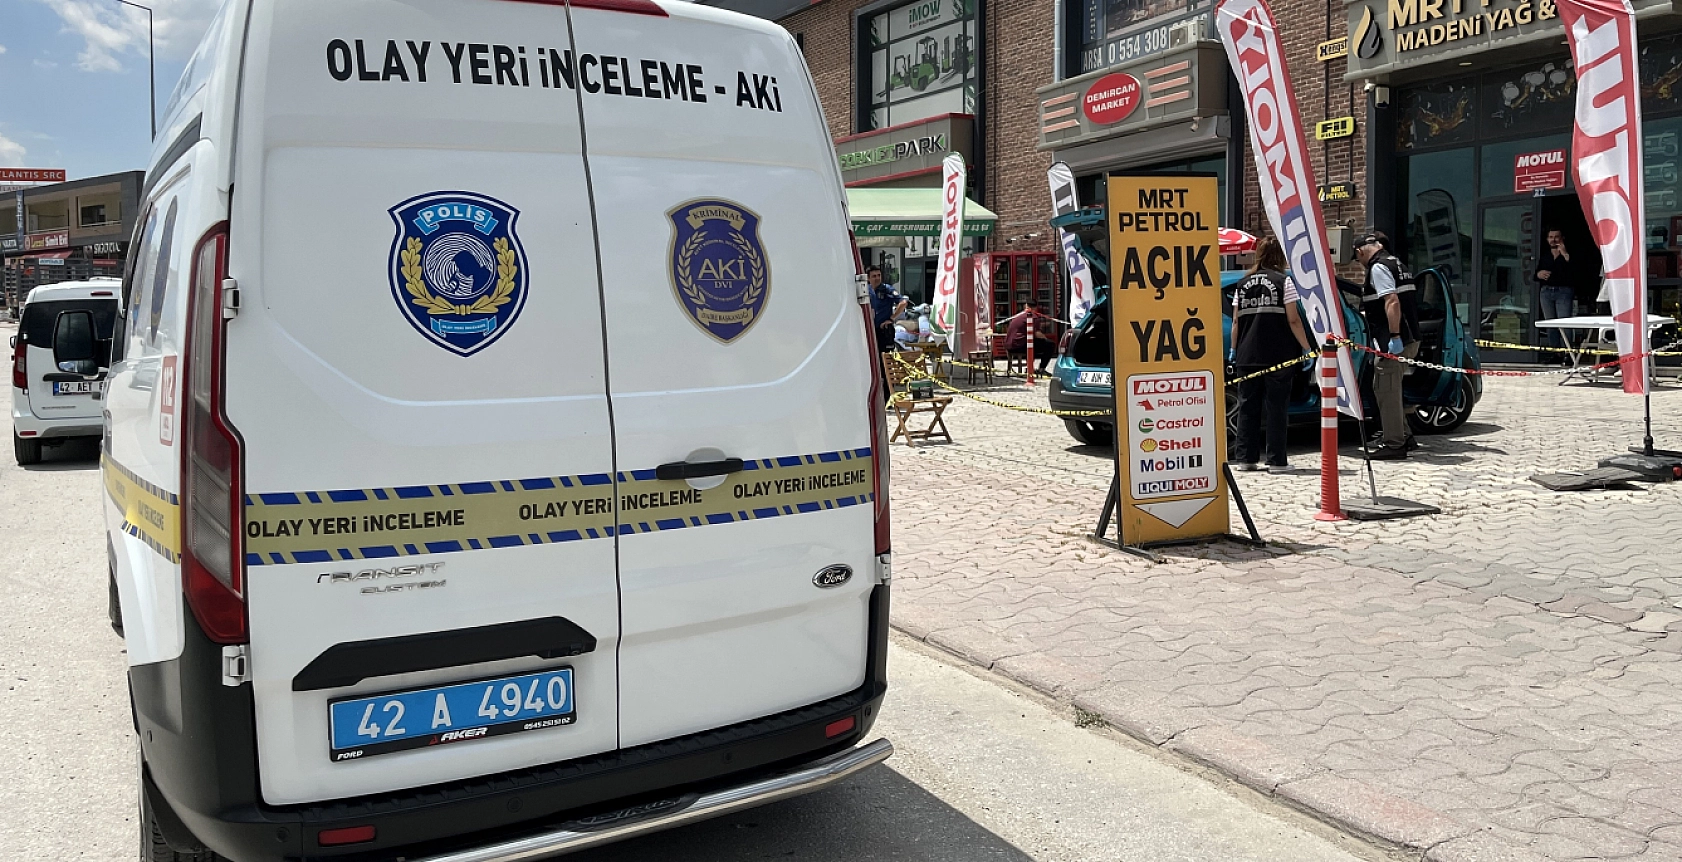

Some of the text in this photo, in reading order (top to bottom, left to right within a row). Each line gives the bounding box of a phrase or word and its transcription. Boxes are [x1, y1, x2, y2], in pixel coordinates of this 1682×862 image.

[1537, 1, 1556, 20] &
[1083, 47, 1102, 72] ARSA
[1119, 35, 1140, 60] 554
[1144, 26, 1168, 53] 308
[326, 38, 431, 82] OLAY
[1091, 97, 1131, 115] MARKET
[1516, 151, 1564, 168] MOTUL
[43, 171, 63, 179] SRC
[1138, 189, 1188, 209] MRT
[422, 205, 486, 223] POLİS
[1119, 212, 1209, 232] PETROL
[1120, 245, 1213, 300] AÇIK
[714, 280, 733, 289] DVI
[1130, 308, 1206, 363] YAĞ
[60, 382, 70, 392] 42
[1136, 377, 1204, 394] MOTUL
[1157, 396, 1207, 408] Petrol Ofisi
[1156, 416, 1204, 430] Castrol
[1158, 437, 1201, 451] Shell
[1140, 456, 1185, 473] Mobil
[733, 481, 772, 499] OLAY
[1139, 477, 1209, 494] LIQUI MOLY
[519, 500, 568, 521] OLAY
[247, 519, 303, 539] OLAY
[357, 675, 567, 738] 42 A 4940
[441, 727, 488, 742] AKER
[336, 750, 364, 761] FORD
